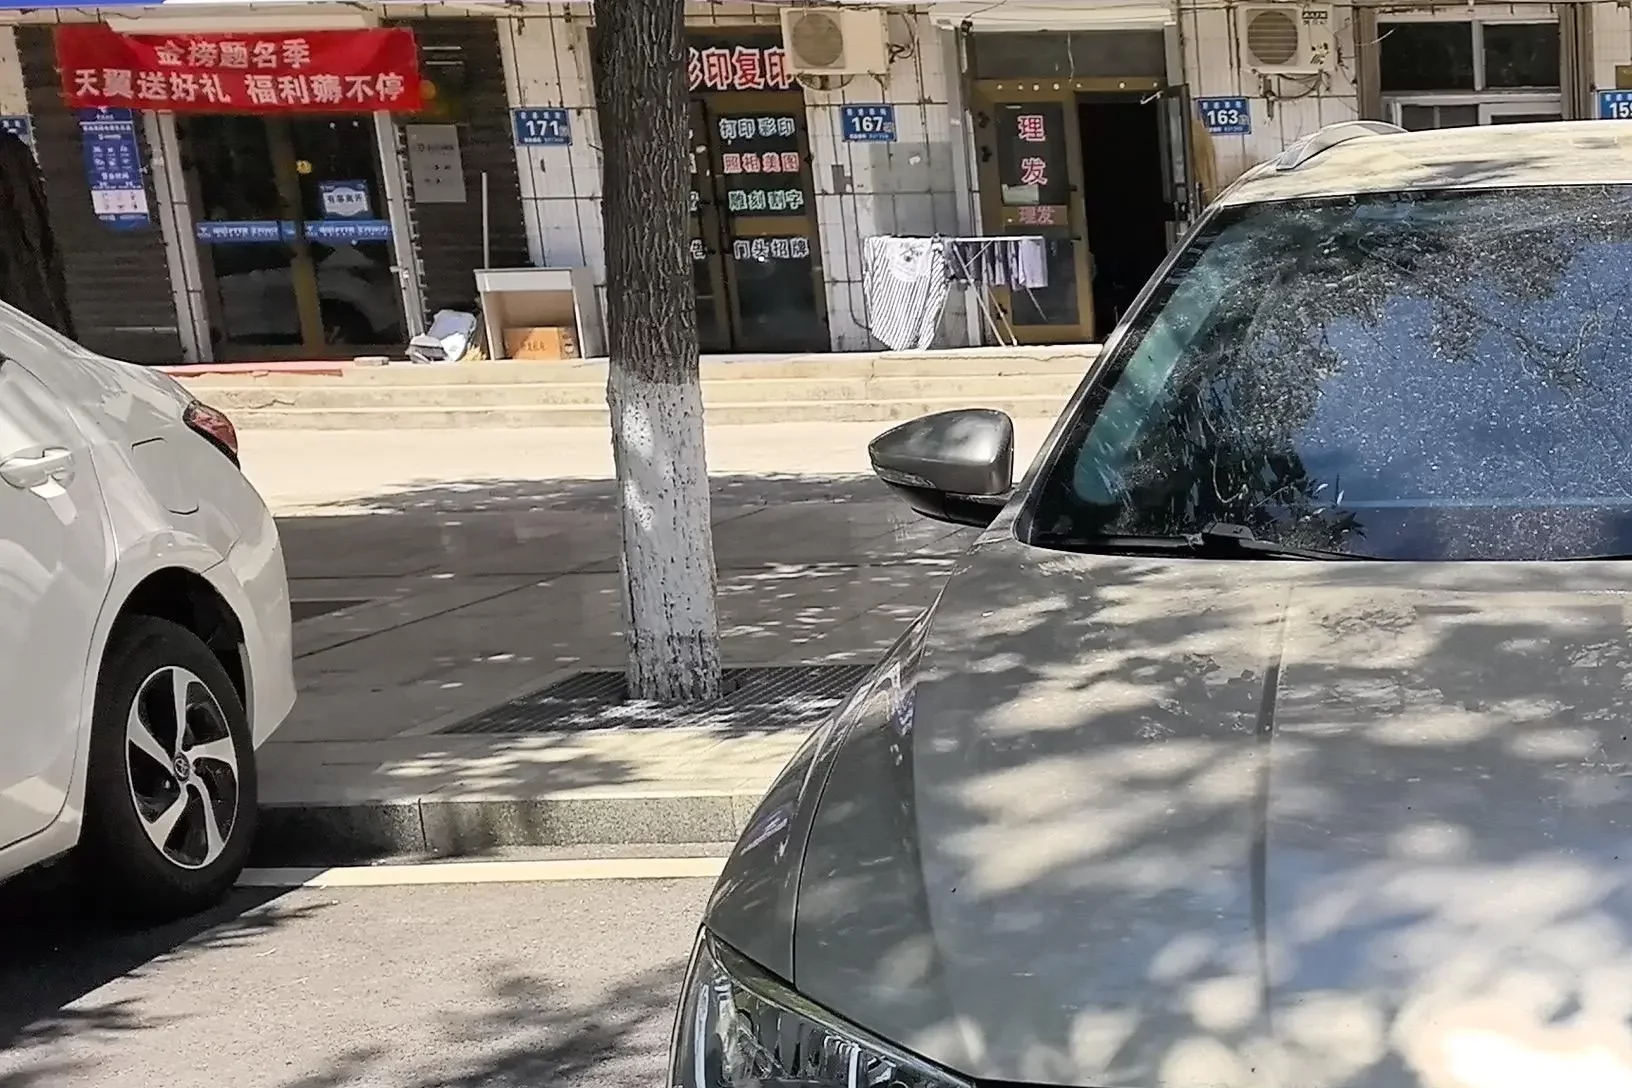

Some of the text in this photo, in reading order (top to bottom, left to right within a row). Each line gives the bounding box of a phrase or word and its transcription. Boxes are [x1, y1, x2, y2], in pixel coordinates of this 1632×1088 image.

[154, 38, 311, 69] 金榜题名季
[74, 68, 231, 102] 天翼送好礼
[851, 116, 883, 132] 167
[1207, 109, 1239, 125] 163
[526, 120, 559, 136] 171
[1016, 115, 1048, 186] 理发
[1018, 205, 1054, 225] 理发
